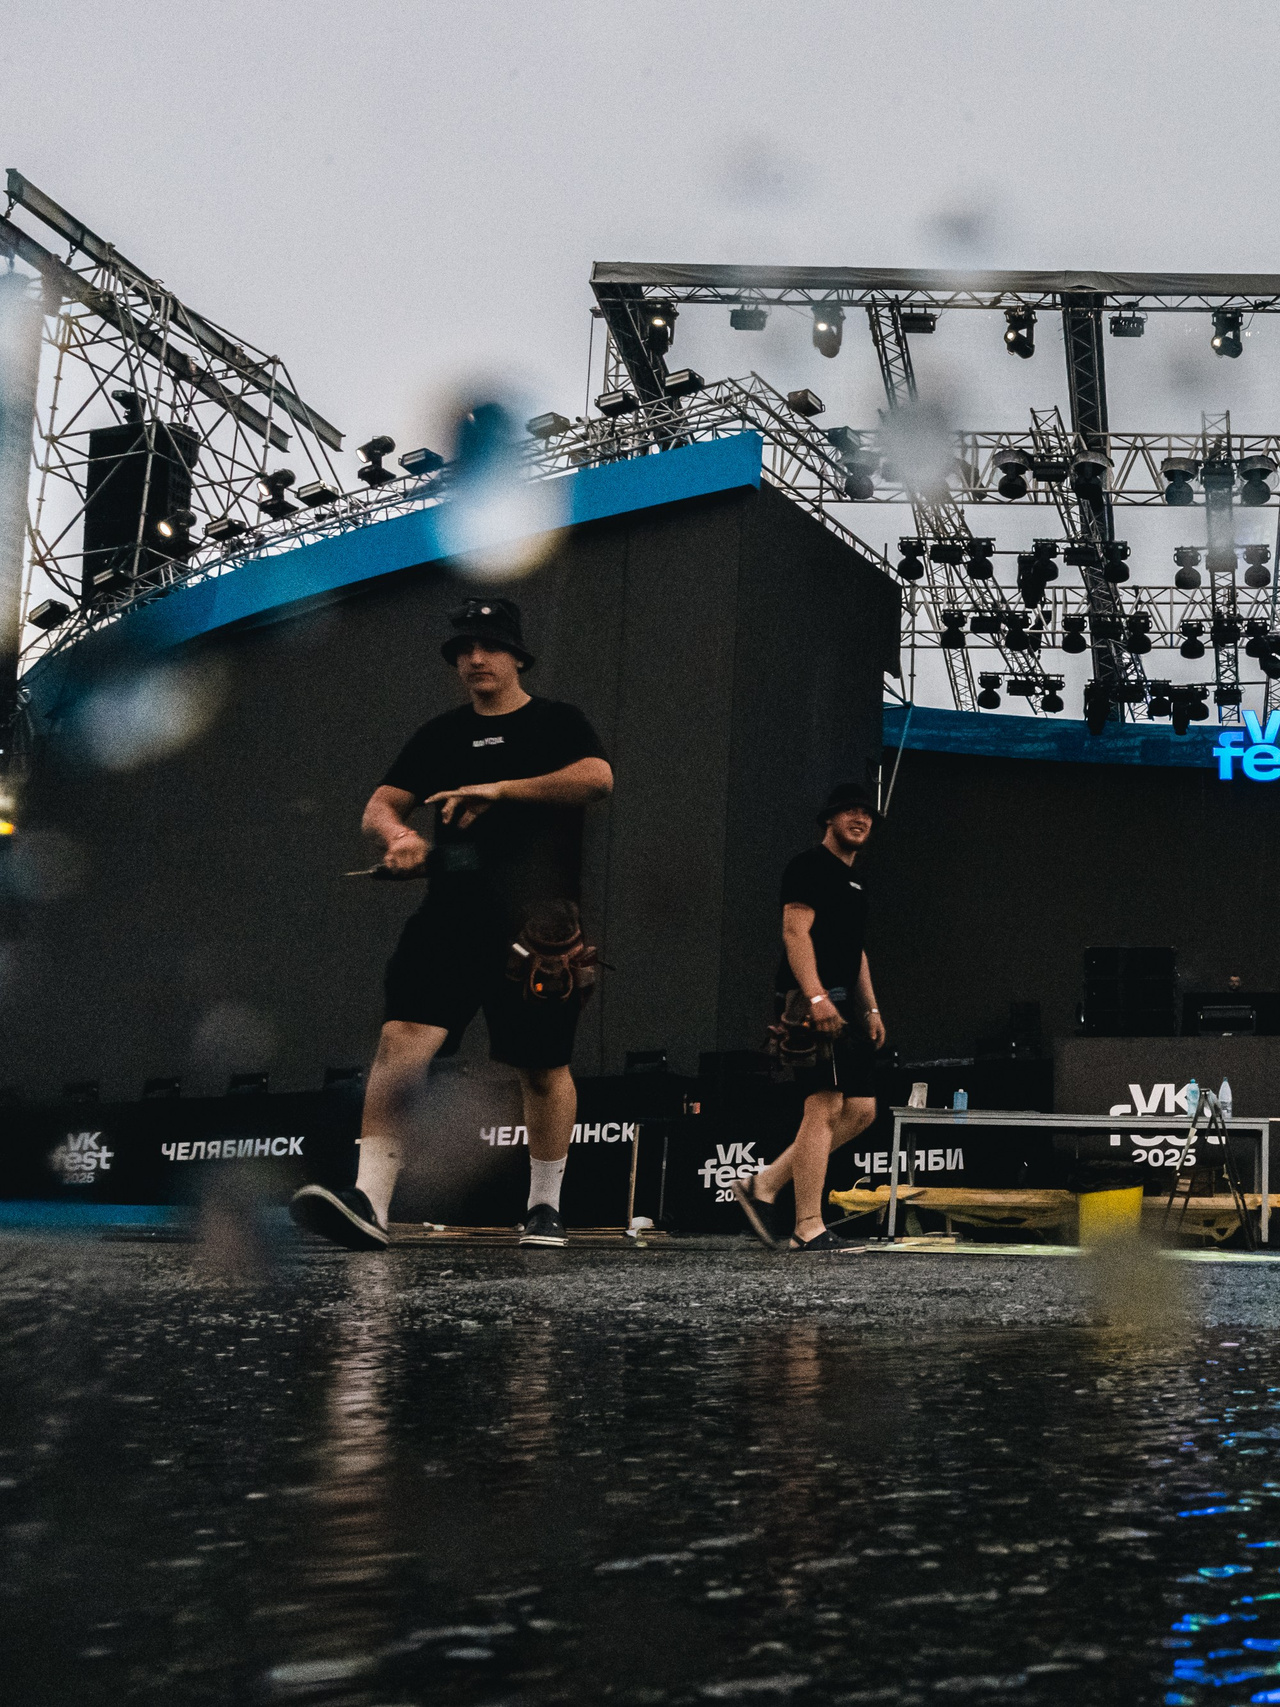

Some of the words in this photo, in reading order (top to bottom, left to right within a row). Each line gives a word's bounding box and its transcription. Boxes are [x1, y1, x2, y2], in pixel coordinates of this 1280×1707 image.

[67, 1131, 102, 1151] VK
[161, 1137, 304, 1161] ЧЕЛЯБИНСК
[716, 1141, 756, 1165] VK
